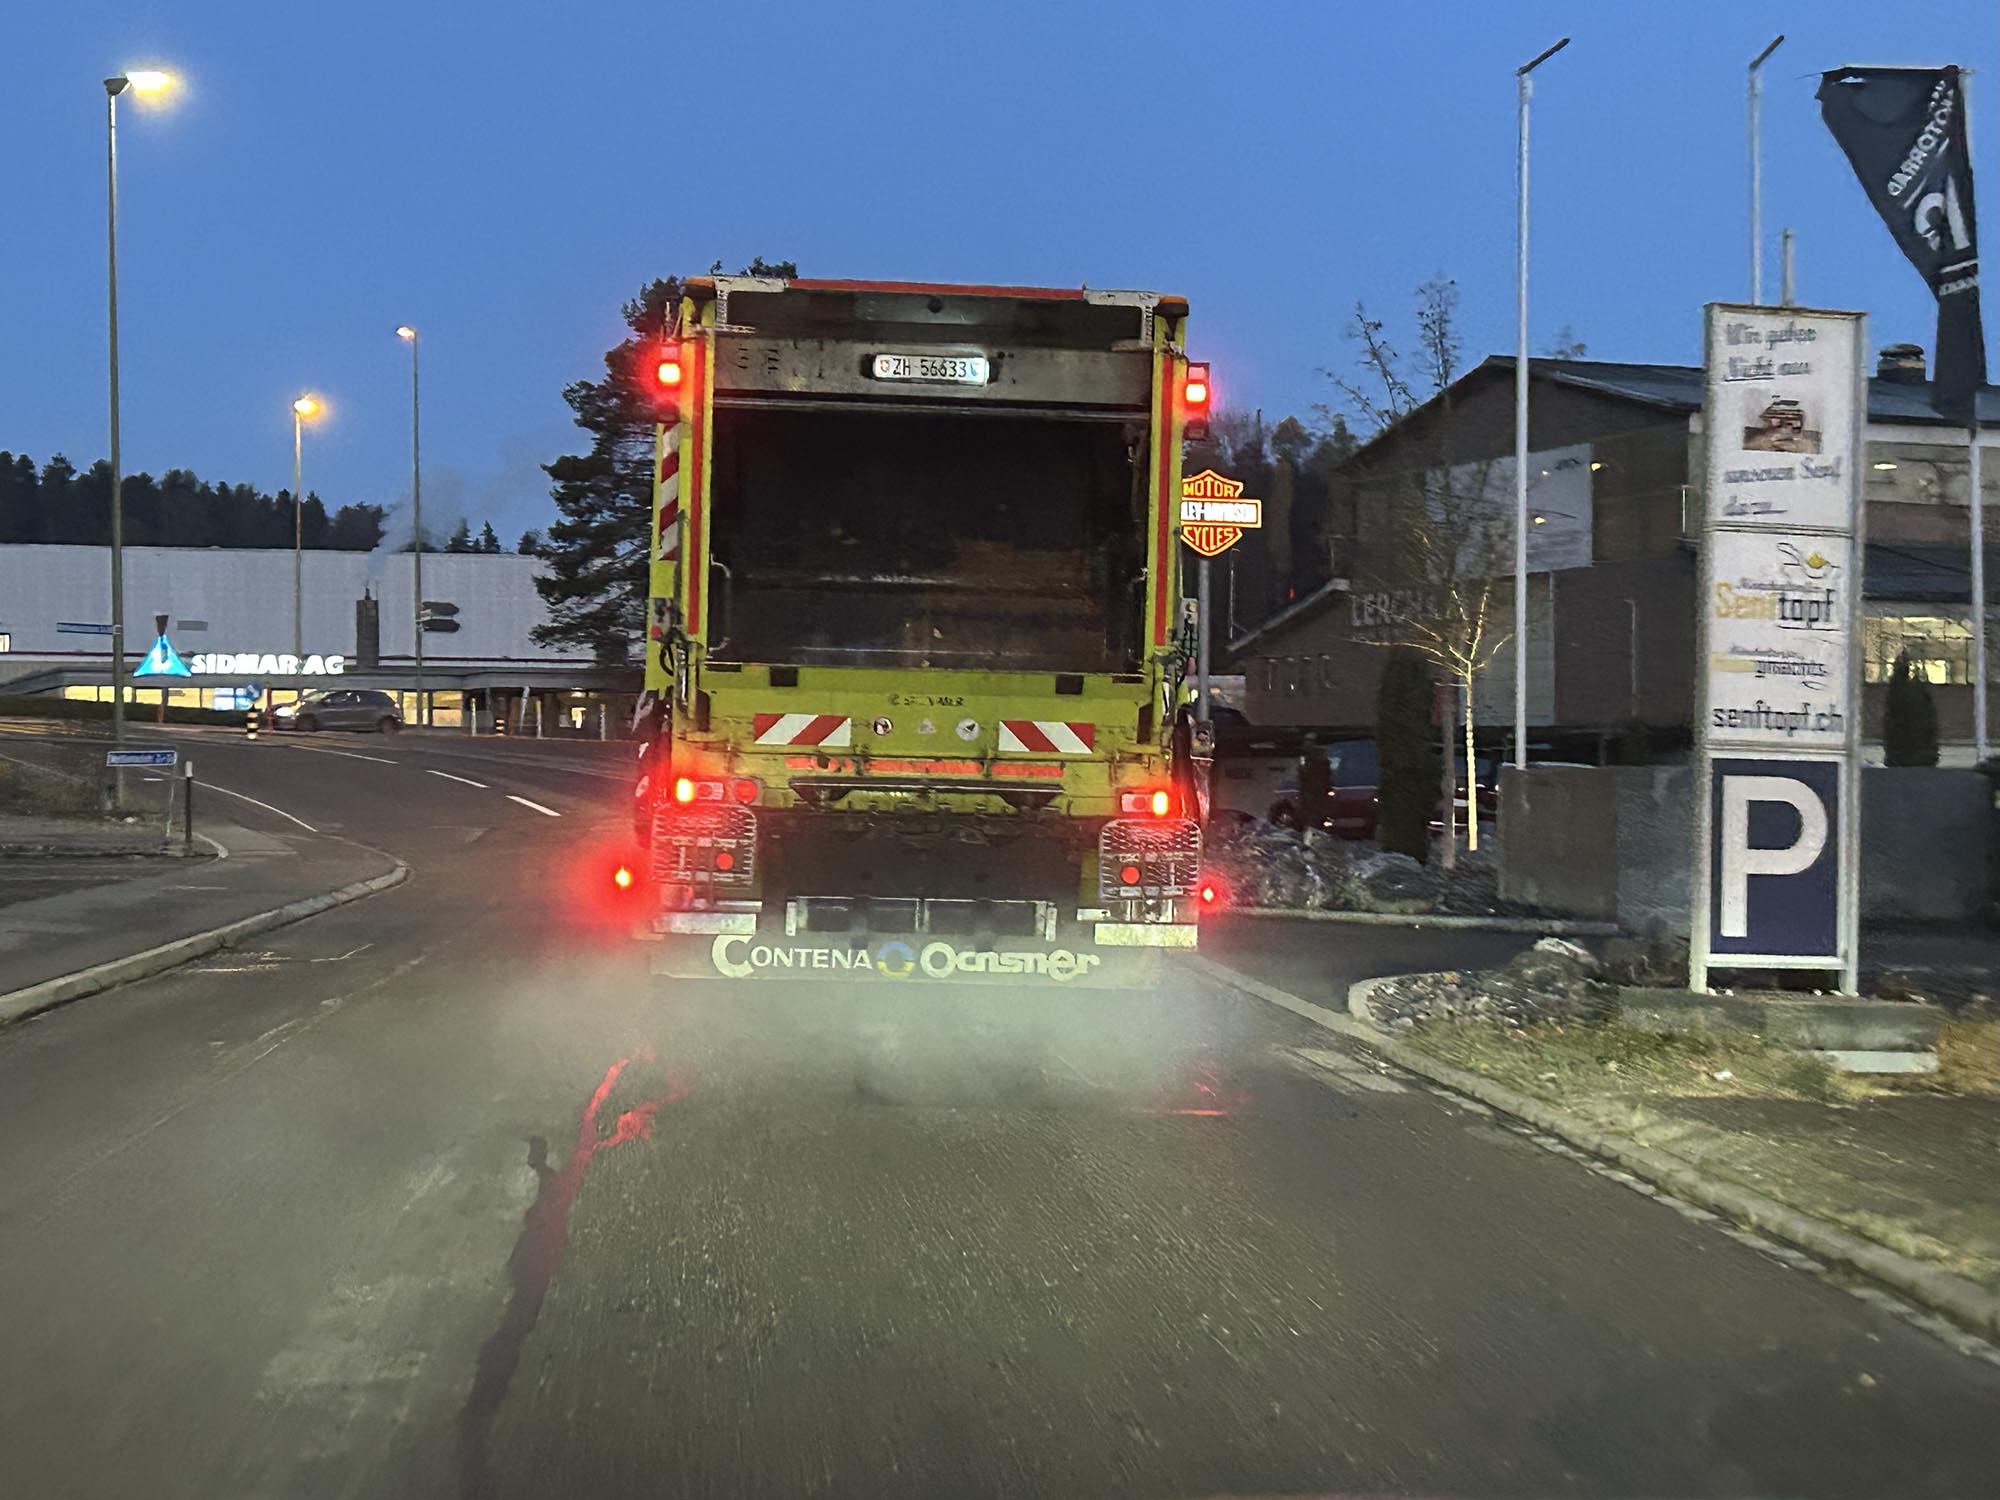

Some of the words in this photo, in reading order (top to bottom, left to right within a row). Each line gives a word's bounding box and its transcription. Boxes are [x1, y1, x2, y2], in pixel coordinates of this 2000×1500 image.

[892, 358, 911, 376] ZH
[1182, 476, 1234, 497] MOTOR
[1183, 526, 1235, 552] CYCLES
[191, 653, 299, 675] SIDMAR
[302, 655, 345, 675] AG
[1720, 775, 1828, 938] P
[711, 935, 873, 978] CONTENA
